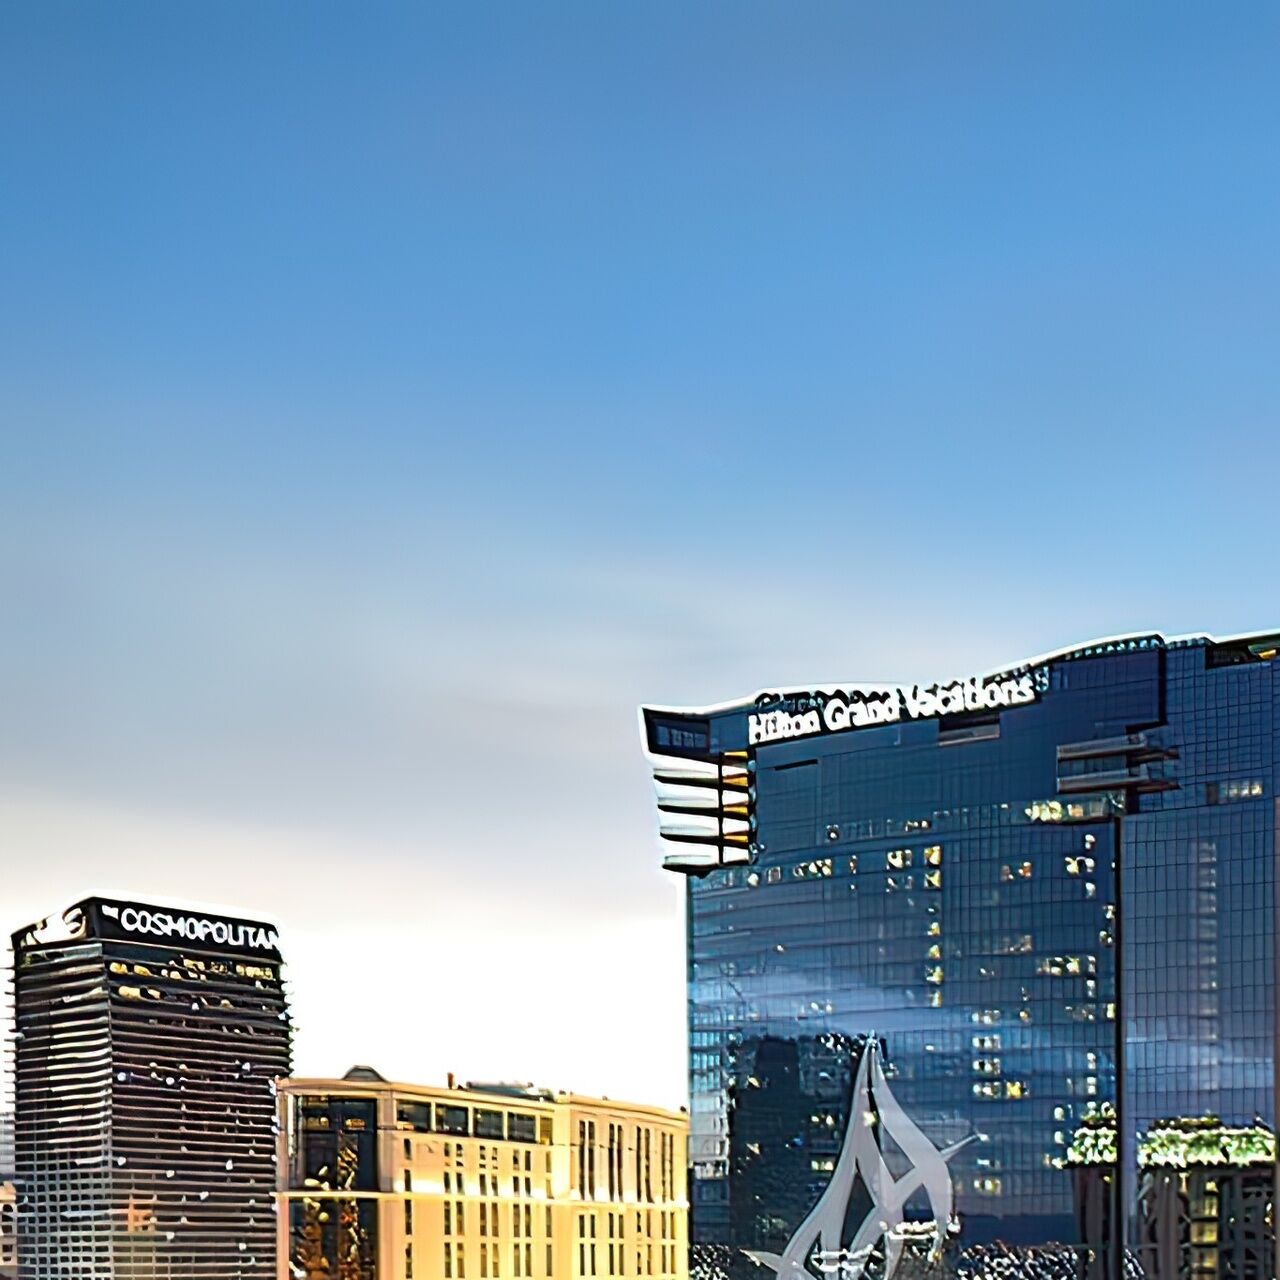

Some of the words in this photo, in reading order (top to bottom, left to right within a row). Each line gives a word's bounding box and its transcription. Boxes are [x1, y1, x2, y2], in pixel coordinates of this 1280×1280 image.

[748, 710, 821, 745] Hilton
[823, 698, 900, 731] Grand
[904, 673, 1036, 718] Vacations
[121, 908, 280, 950] COSMOPOLITAN
